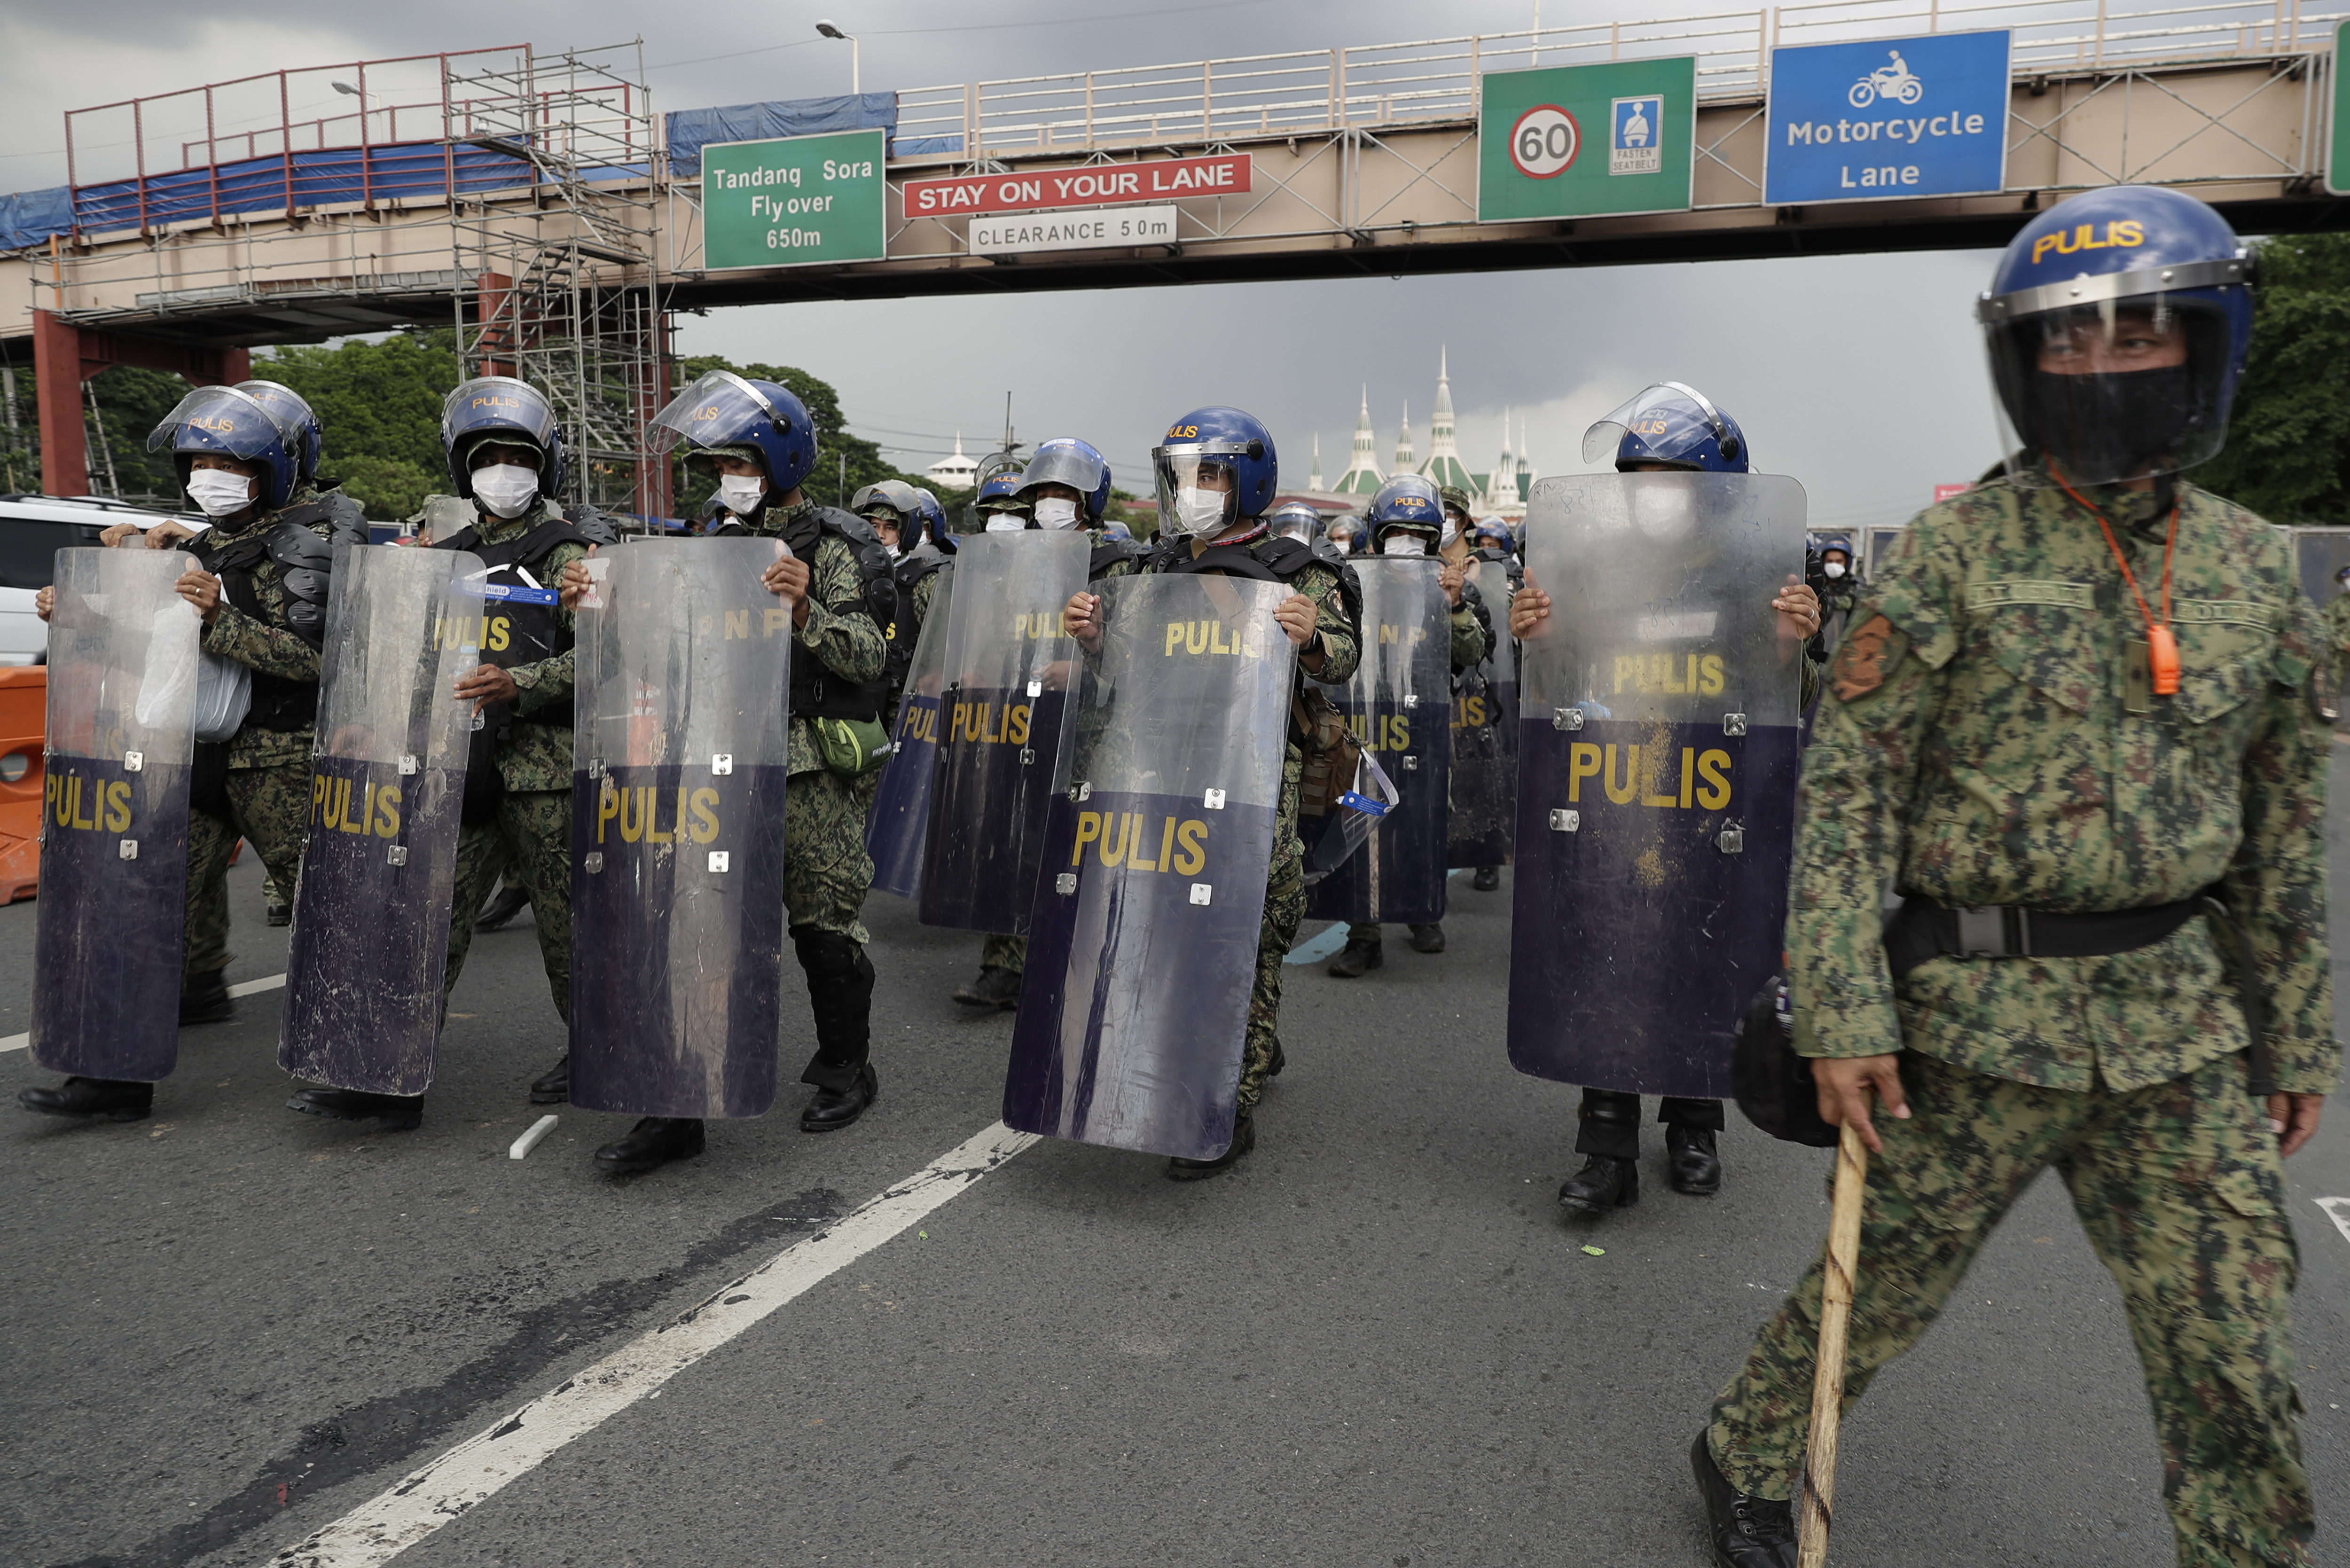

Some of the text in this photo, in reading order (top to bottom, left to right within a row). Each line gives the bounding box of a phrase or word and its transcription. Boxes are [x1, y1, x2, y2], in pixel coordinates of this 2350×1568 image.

[1519, 123, 1572, 162] 60
[1787, 111, 1985, 146] Motorcycle
[1613, 160, 1656, 171] SEATBELT
[1617, 149, 1652, 159] FASTEN
[713, 160, 873, 189] Tandang Sora
[918, 164, 1235, 210] STAY ON YOUR LANE
[1841, 165, 1920, 188] Lane
[752, 195, 834, 222] Flyover
[767, 228, 821, 249] 650m
[978, 221, 1105, 246] CLEARANCE
[2032, 220, 2145, 264] PULIS
[472, 396, 520, 409] PULIS
[693, 407, 719, 421] ULIS
[188, 417, 234, 432] PULIS
[1165, 425, 1198, 440] PULIS
[1395, 497, 1426, 507] PULIS
[433, 615, 510, 652] PULIS
[1015, 612, 1074, 641] PULI
[1614, 654, 1724, 695] PULIS
[902, 706, 939, 744] PUL
[950, 702, 1032, 745] PULIS
[1568, 742, 1732, 810] PULIS
[47, 773, 132, 833] PULIS
[311, 774, 403, 839] PULIS
[597, 786, 720, 844] PULIS
[1072, 811, 1208, 876] PULIS
